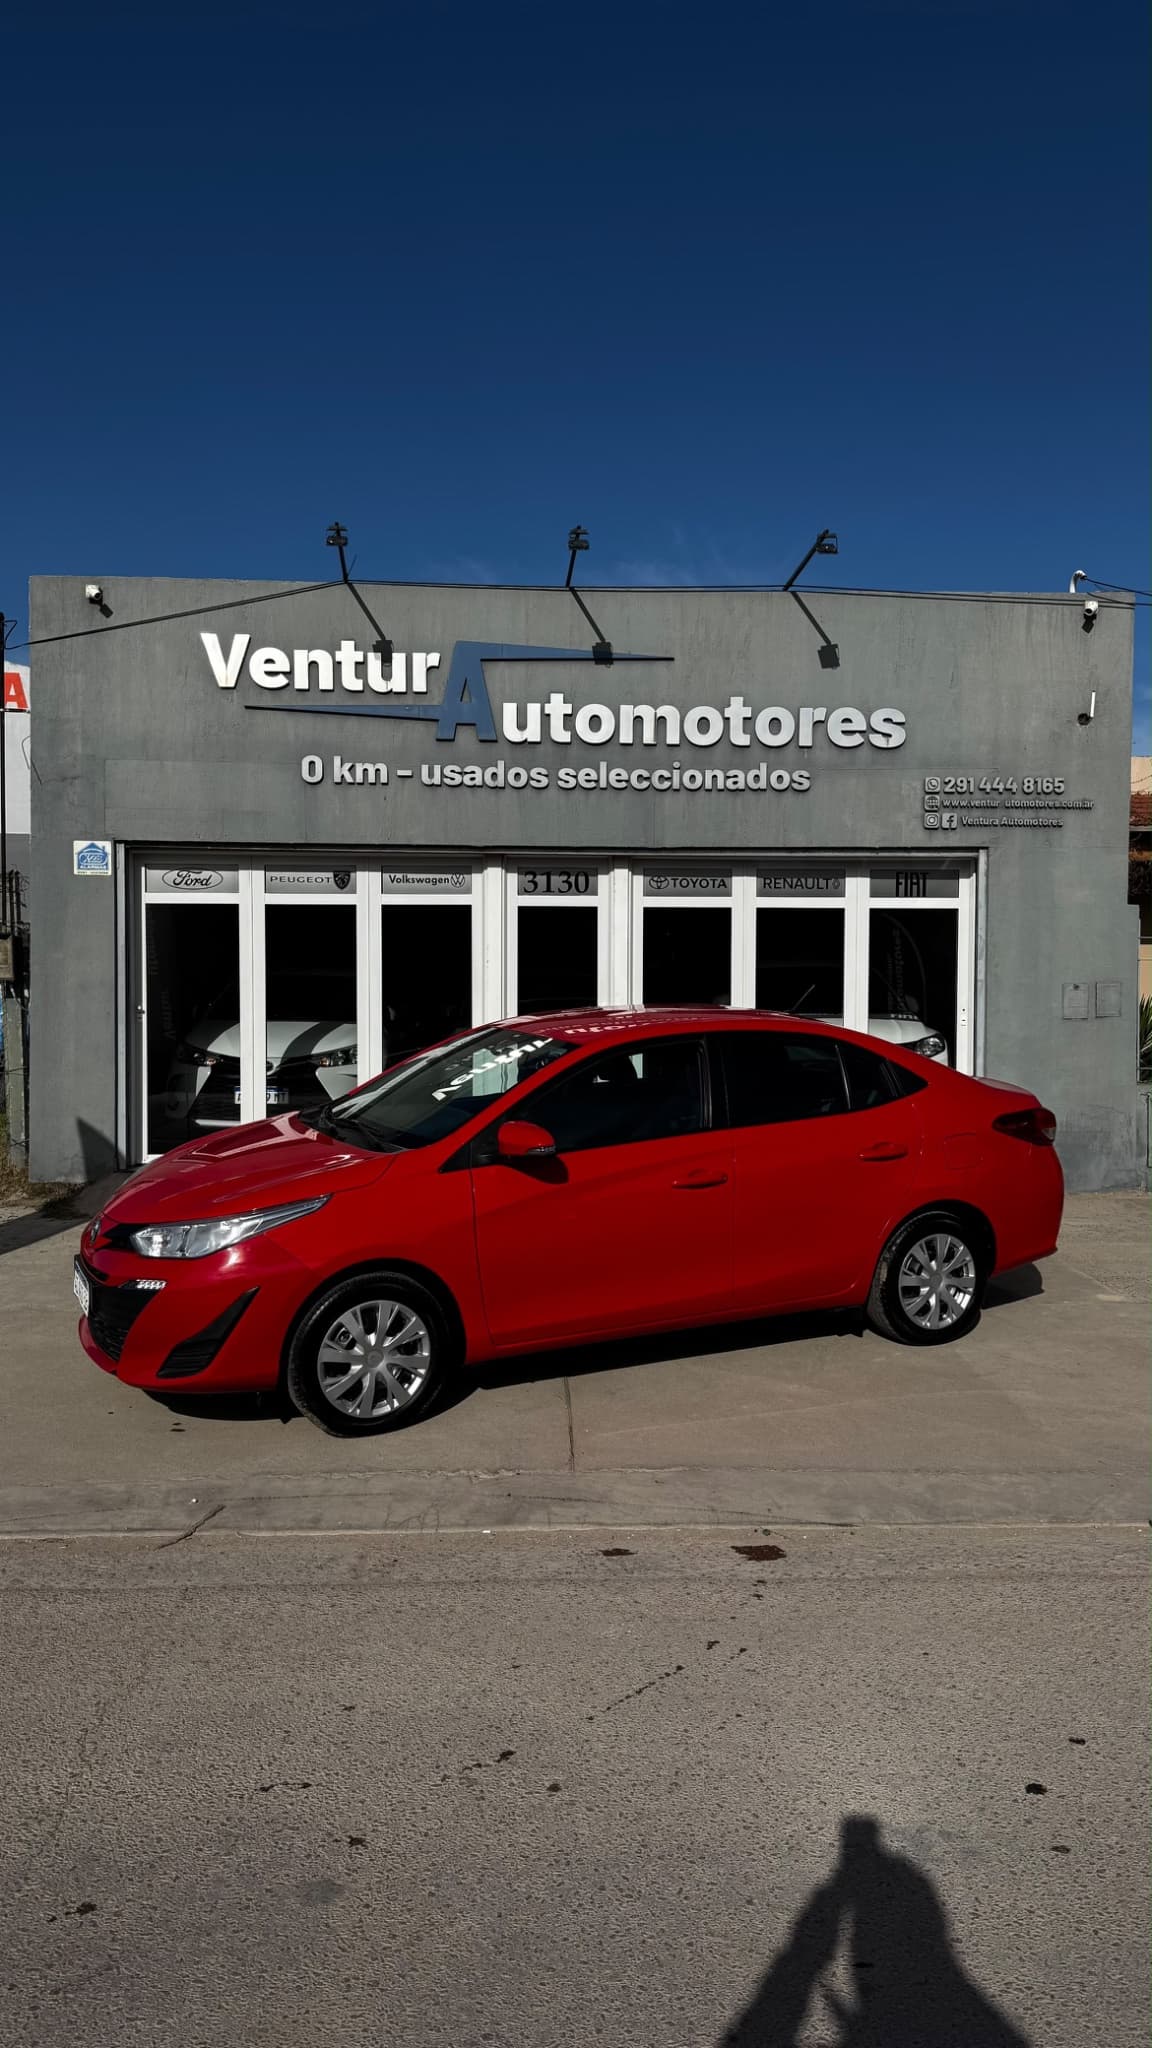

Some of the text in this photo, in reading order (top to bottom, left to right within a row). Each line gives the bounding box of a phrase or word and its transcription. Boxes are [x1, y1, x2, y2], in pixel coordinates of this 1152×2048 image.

[301, 754, 323, 784] 0
[333, 755, 388, 784] km
[421, 760, 549, 789] usados
[557, 761, 811, 791] seleccionados
[944, 777, 1065, 793] 291 444 8165
[962, 816, 999, 827] Ventura
[1001, 817, 1064, 827] Automotores
[173, 869, 212, 887] Ford
[270, 876, 332, 884] PEUGEOT
[388, 874, 450, 887] Volkswagen
[523, 871, 590, 894] 3130
[671, 877, 727, 889] TOYOTA
[763, 877, 832, 890] RENAULT
[896, 872, 929, 897] FIAT
